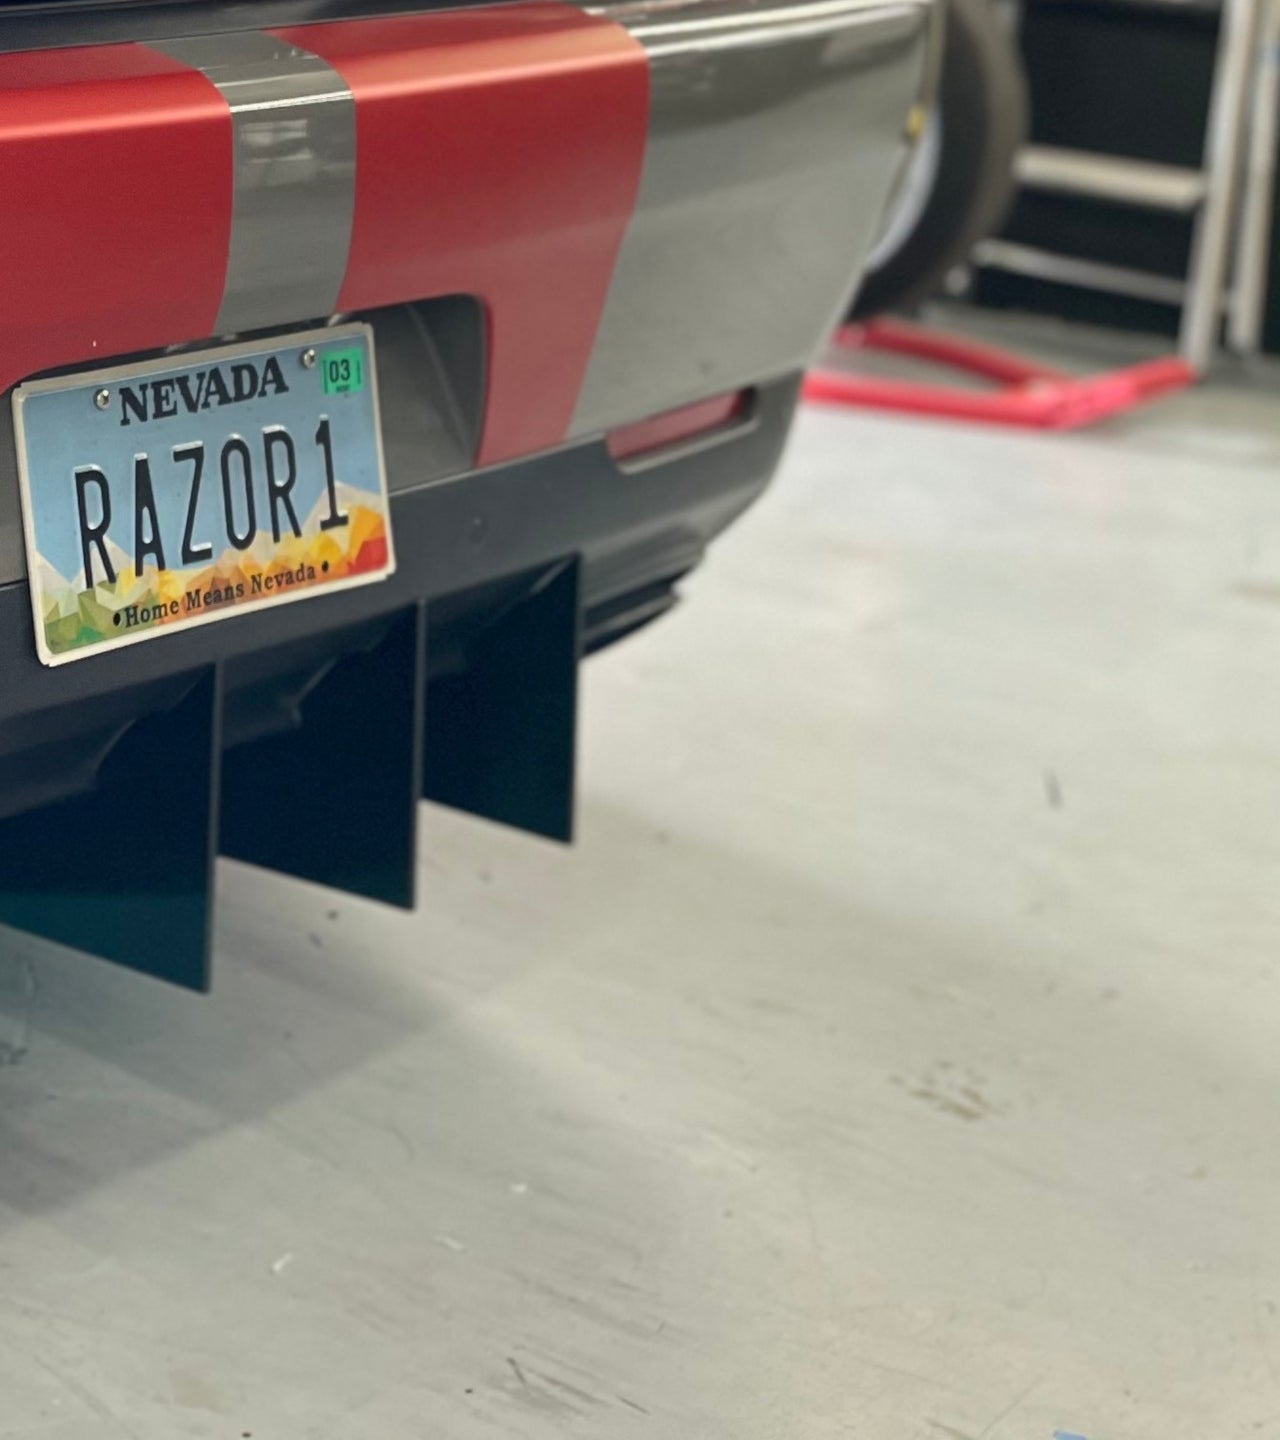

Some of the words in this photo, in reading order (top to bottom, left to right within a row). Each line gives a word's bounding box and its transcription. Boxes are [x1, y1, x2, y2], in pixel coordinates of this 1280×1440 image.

[118, 356, 290, 426] NEVADA
[328, 357, 352, 383] 03
[73, 413, 349, 589] RAZOR1
[125, 598, 180, 628] Home
[185, 582, 245, 612] Means
[250, 563, 317, 594] Nevada
